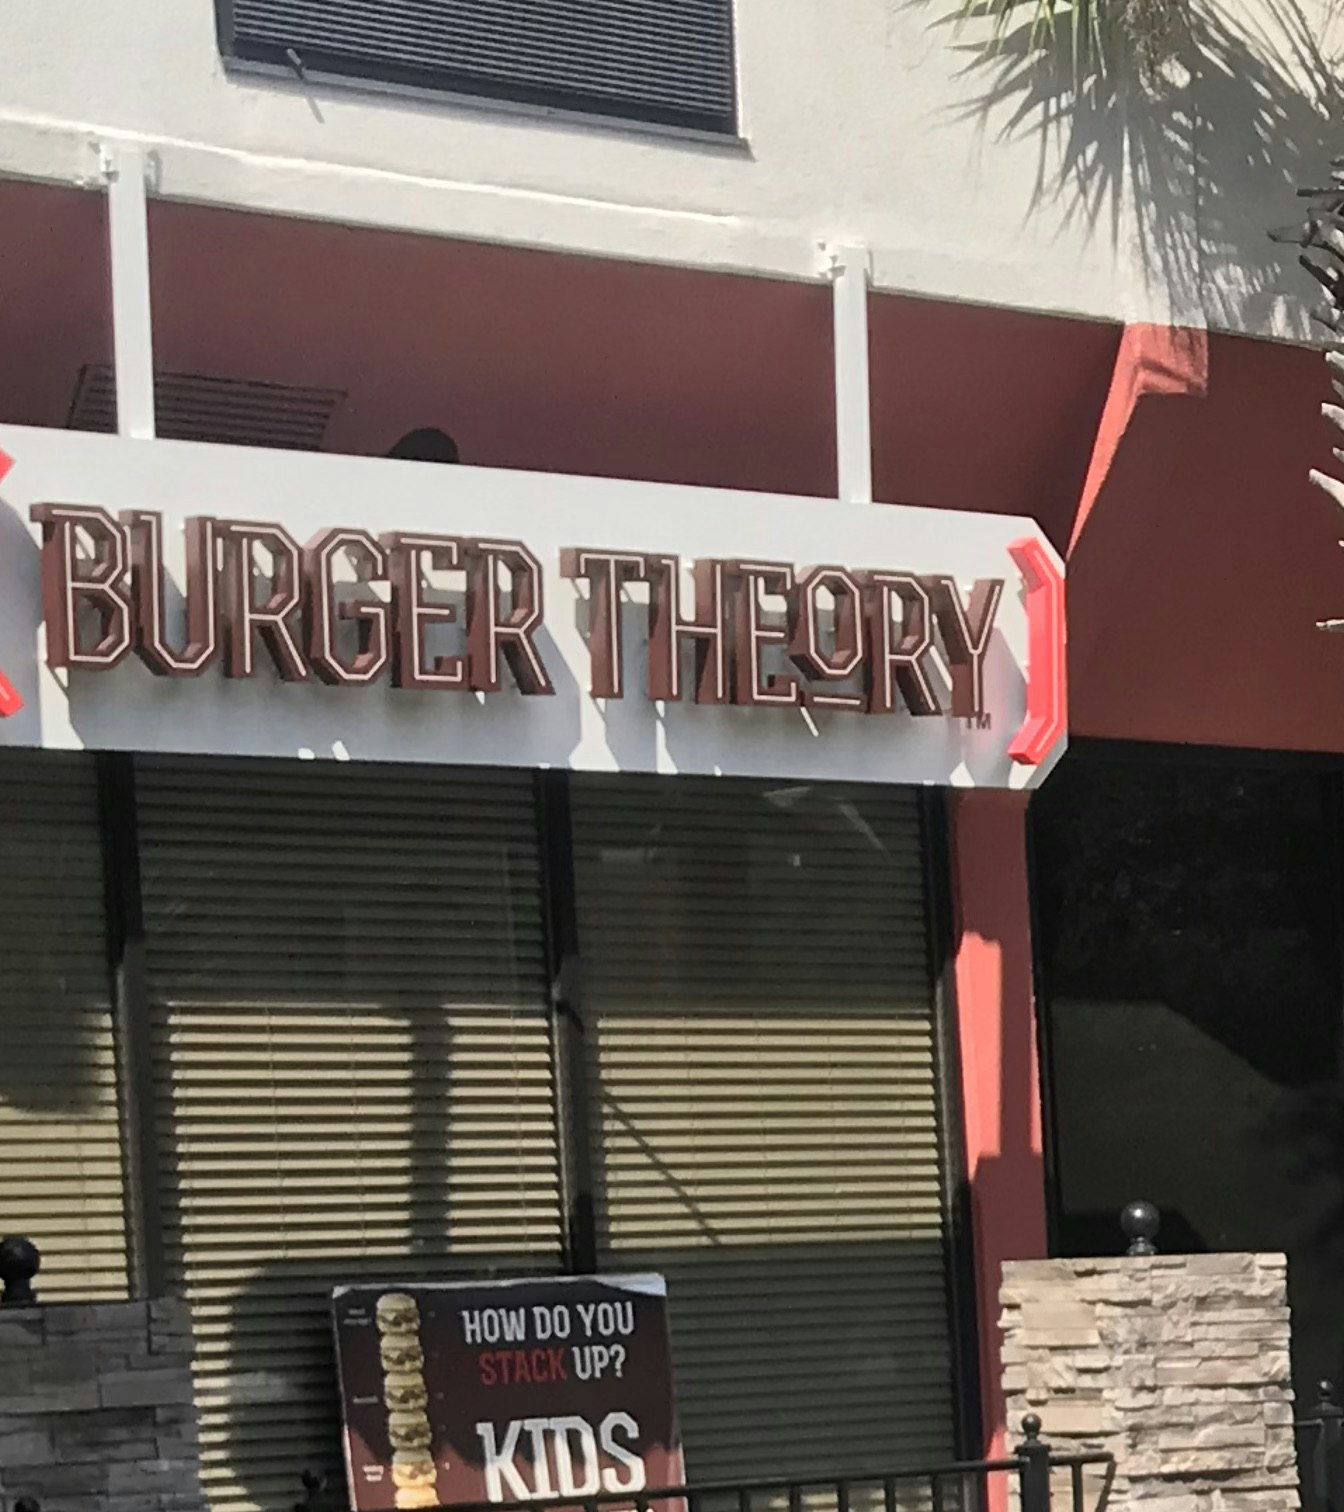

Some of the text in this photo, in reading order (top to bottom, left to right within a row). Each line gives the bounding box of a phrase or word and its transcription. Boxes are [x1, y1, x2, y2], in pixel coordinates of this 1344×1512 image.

[30, 503, 1005, 718] BURGER THEORY
[461, 1301, 635, 1344] HOW DO YOU
[478, 1344, 627, 1385] STACK UP?
[475, 1411, 647, 1503] KIDS
